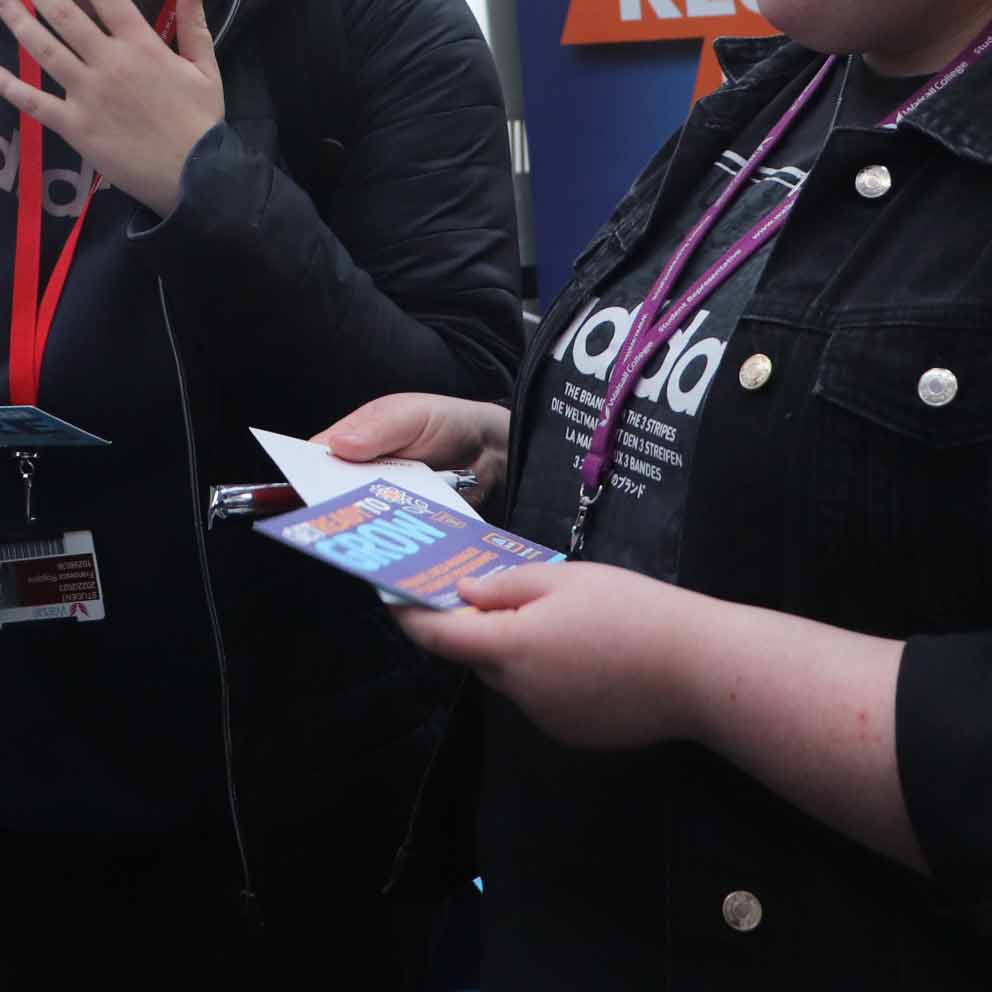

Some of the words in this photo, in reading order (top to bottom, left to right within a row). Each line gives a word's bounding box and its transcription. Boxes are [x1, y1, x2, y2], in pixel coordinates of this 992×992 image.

[551, 397, 565, 415] DIE
[564, 404, 600, 430] WELTMA
[622, 431, 638, 451] DEN
[645, 440, 683, 468] STREIFEN
[563, 381, 580, 401] THE
[579, 389, 606, 411] BRAN
[626, 409, 642, 428] THE
[645, 418, 678, 442] STRIPES
[565, 426, 576, 445] LA
[629, 455, 663, 482] BANDES
[314, 510, 447, 572] GROW
